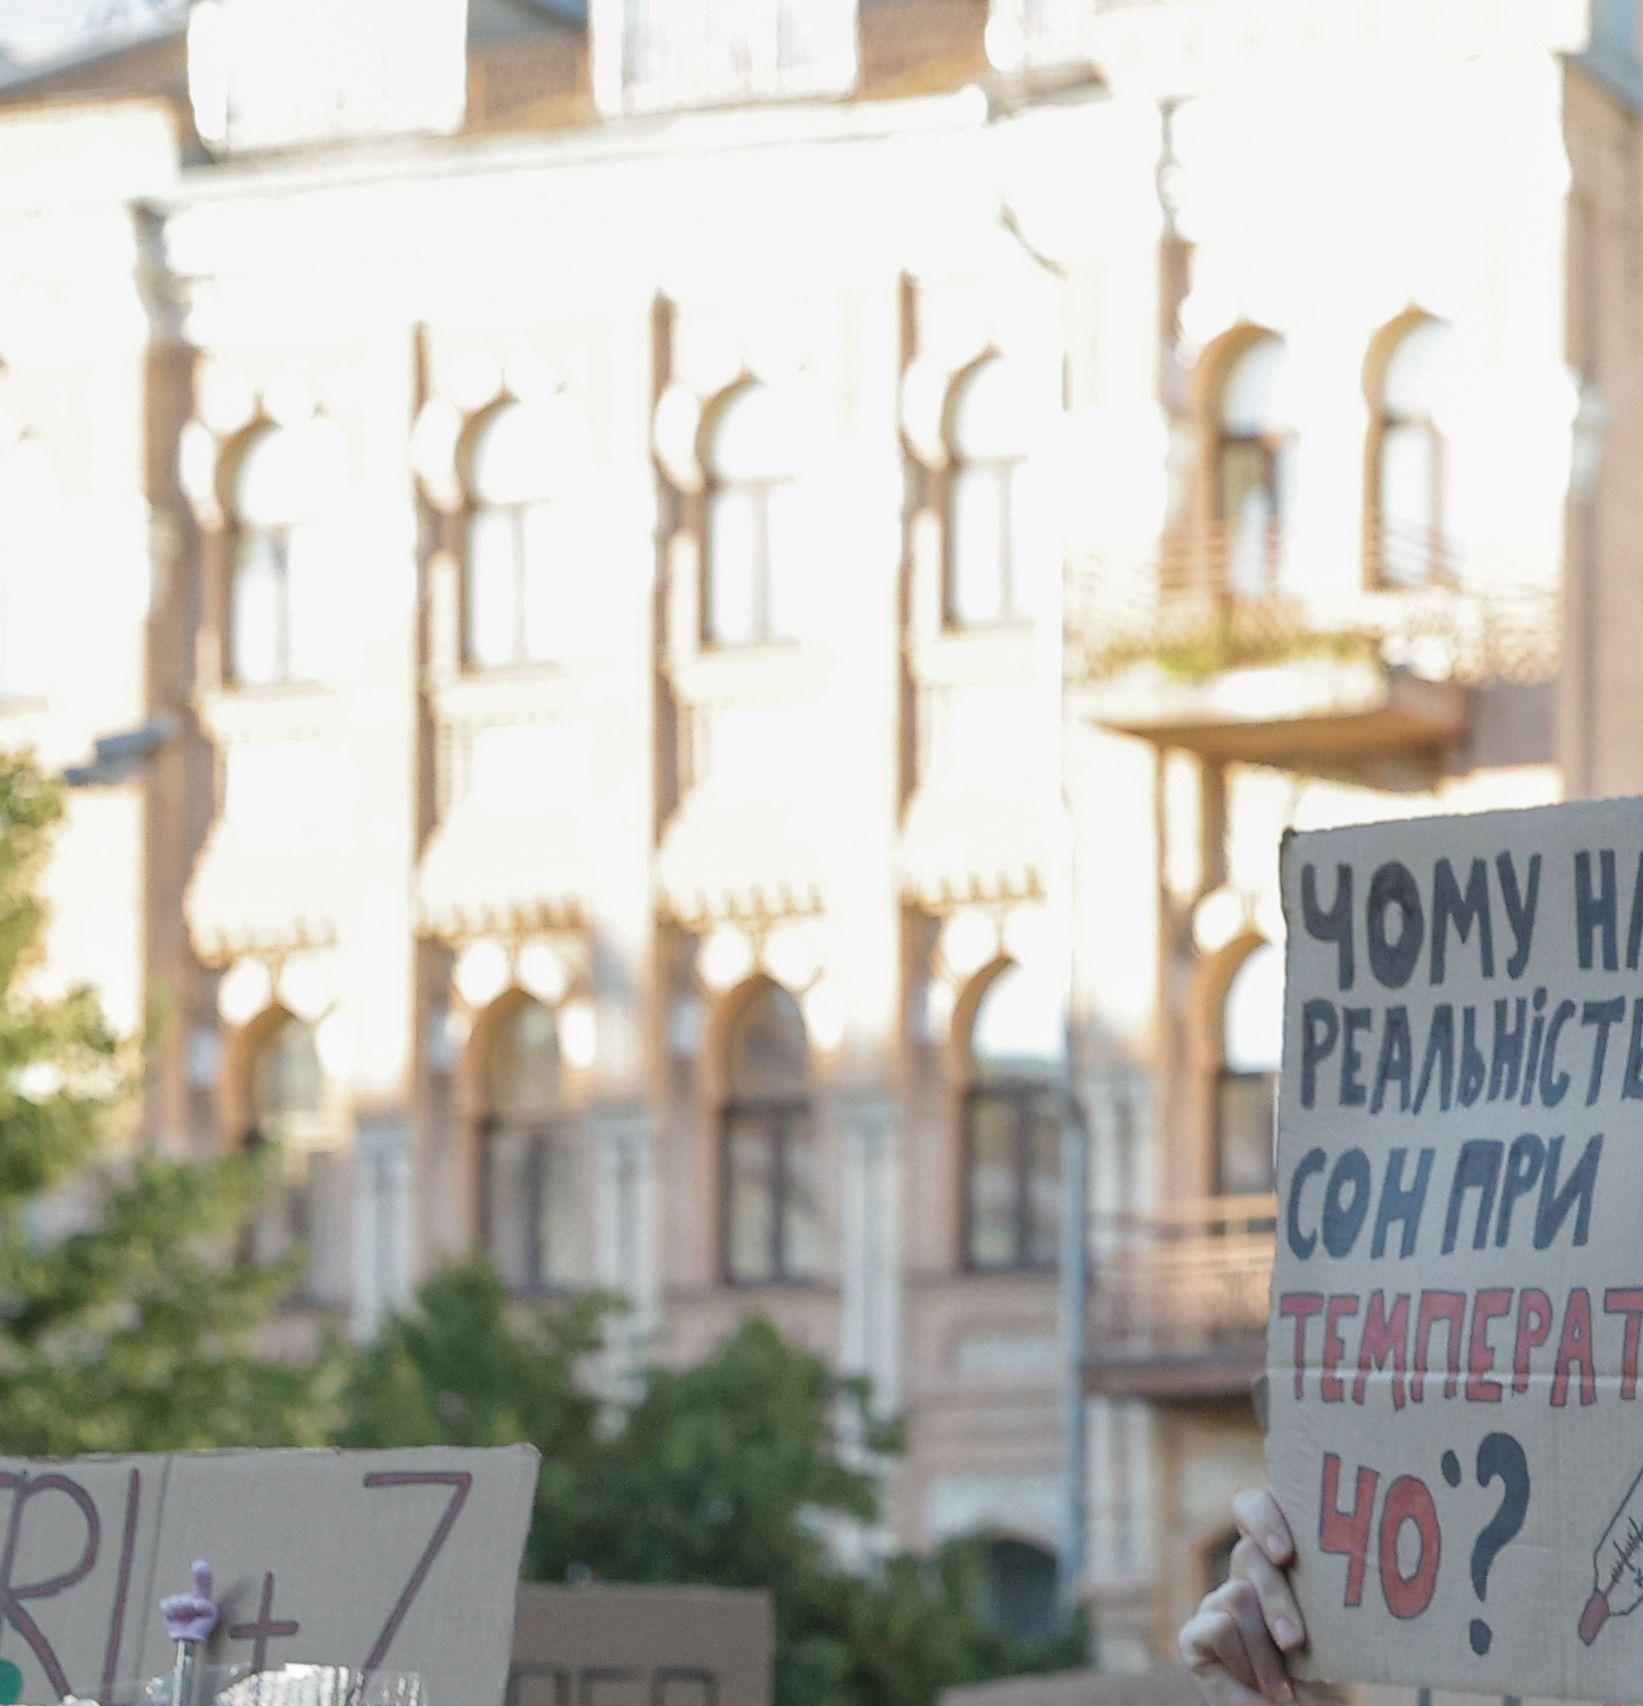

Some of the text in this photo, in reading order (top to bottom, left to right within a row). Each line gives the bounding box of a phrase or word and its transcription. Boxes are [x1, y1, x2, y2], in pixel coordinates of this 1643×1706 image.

[1301, 850, 1542, 991] ЧОМУ
[1285, 1132, 1604, 1260] СОН ПРИ
